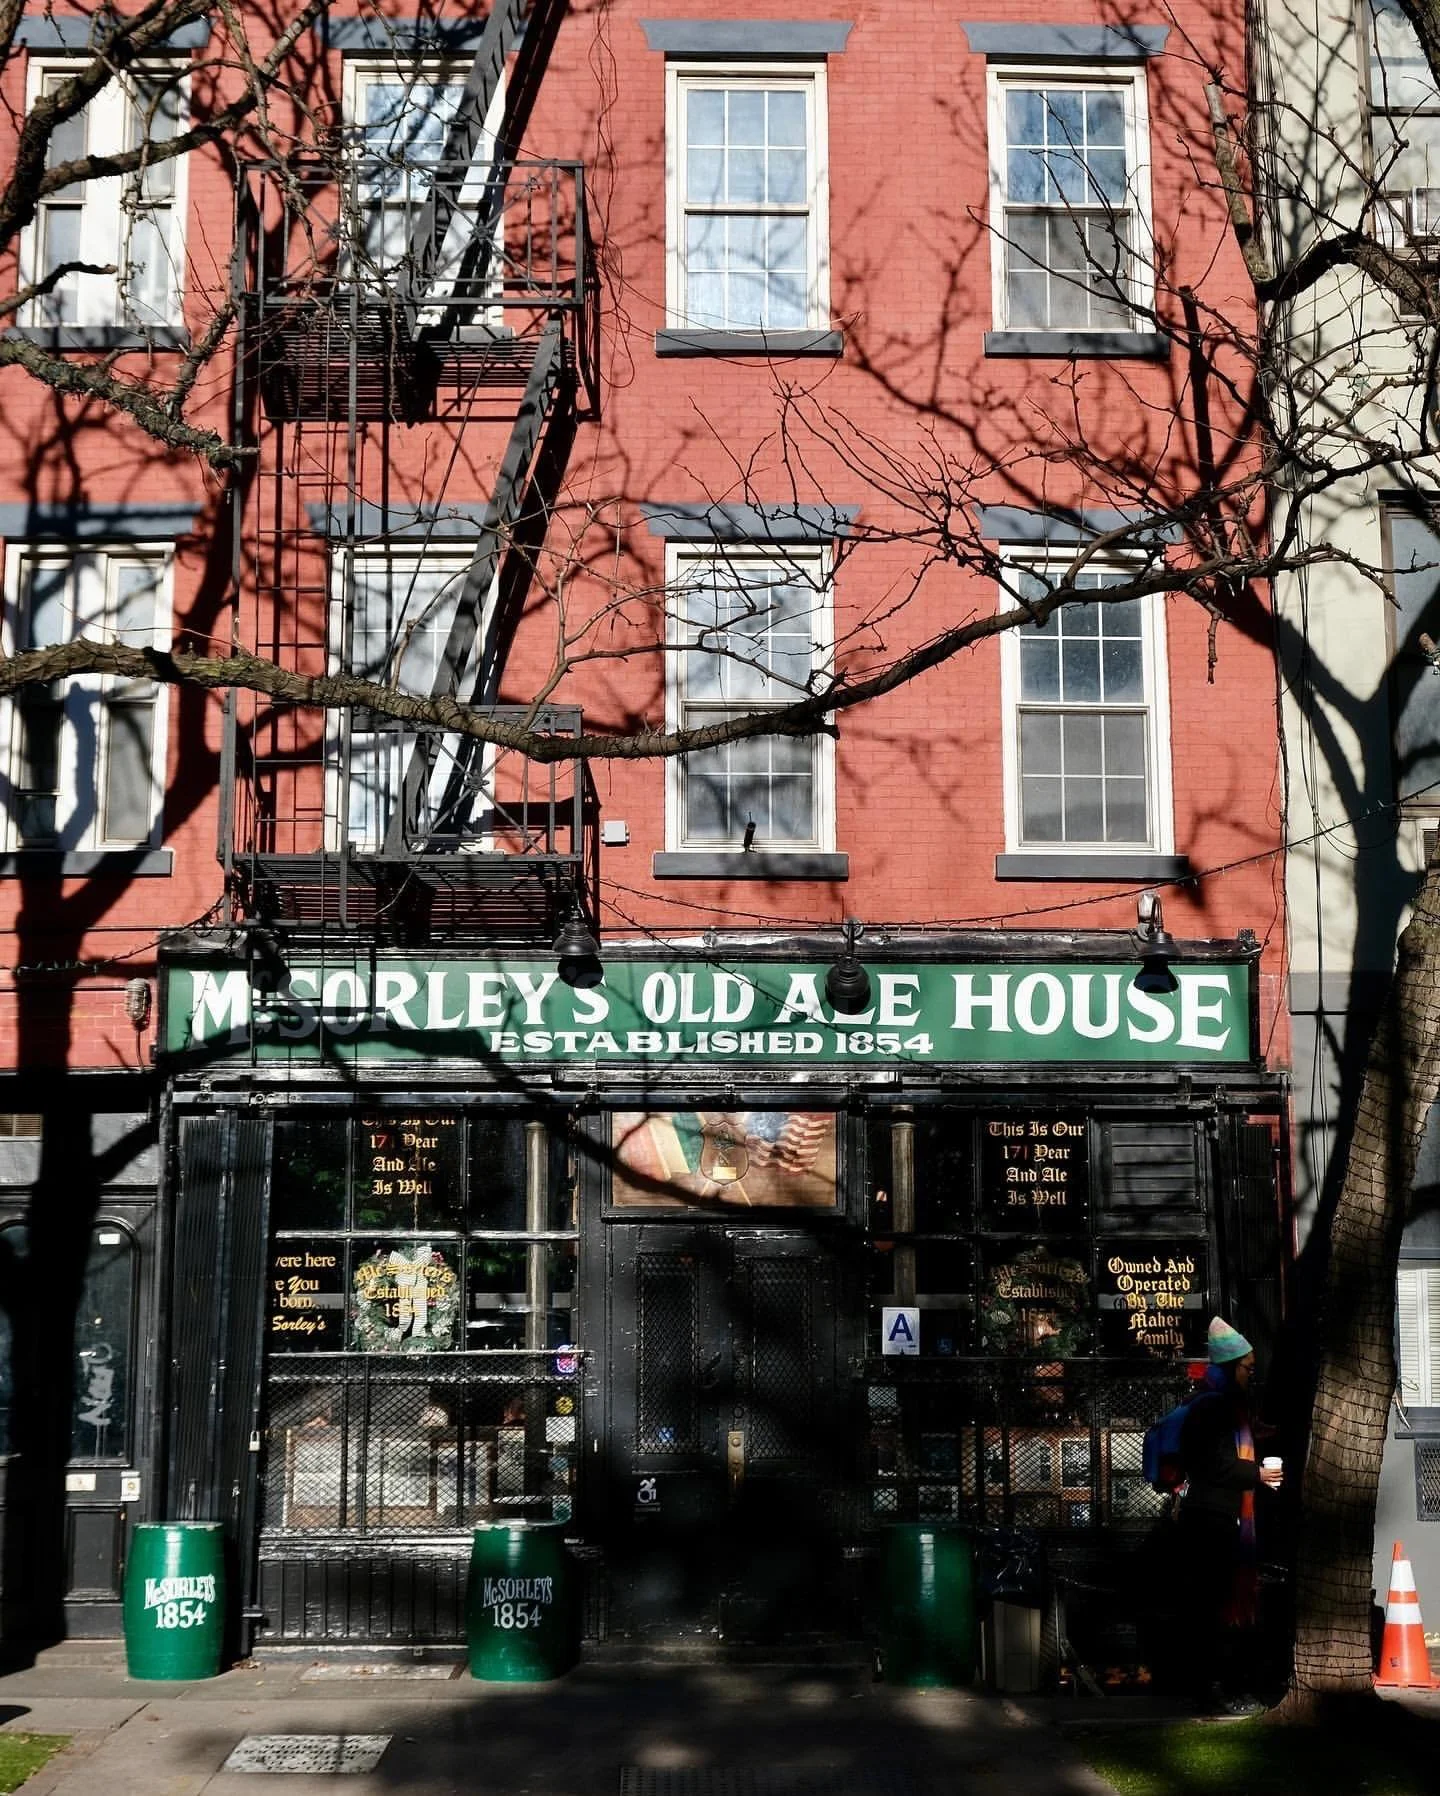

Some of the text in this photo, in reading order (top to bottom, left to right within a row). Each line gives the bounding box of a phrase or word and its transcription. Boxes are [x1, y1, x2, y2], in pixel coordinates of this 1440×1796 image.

[641, 971, 755, 1025] OLD
[951, 972, 1232, 1052] HOUSE
[490, 1031, 934, 1055] ESTABLISHED 1854
[988, 1121, 1085, 1138] This Is Our
[401, 1133, 440, 1151] Year
[1002, 1144, 1071, 1162] 171 Year
[372, 1156, 405, 1172] And
[1006, 1167, 1068, 1182] And Ale
[372, 1179, 433, 1195] Is Well
[1007, 1190, 1067, 1206] Is Well
[304, 1251, 337, 1268] here
[1108, 1255, 1195, 1274] Owned And
[287, 1275, 320, 1295] You
[1117, 1274, 1191, 1293] Operated
[1125, 1292, 1184, 1312] By The
[271, 1313, 327, 1335] Sorley's
[888, 1313, 913, 1341] A
[1128, 1312, 1182, 1330] Maher
[1135, 1329, 1184, 1349] Family
[155, 1600, 207, 1629] 1854
[492, 1602, 542, 1629] 1854
